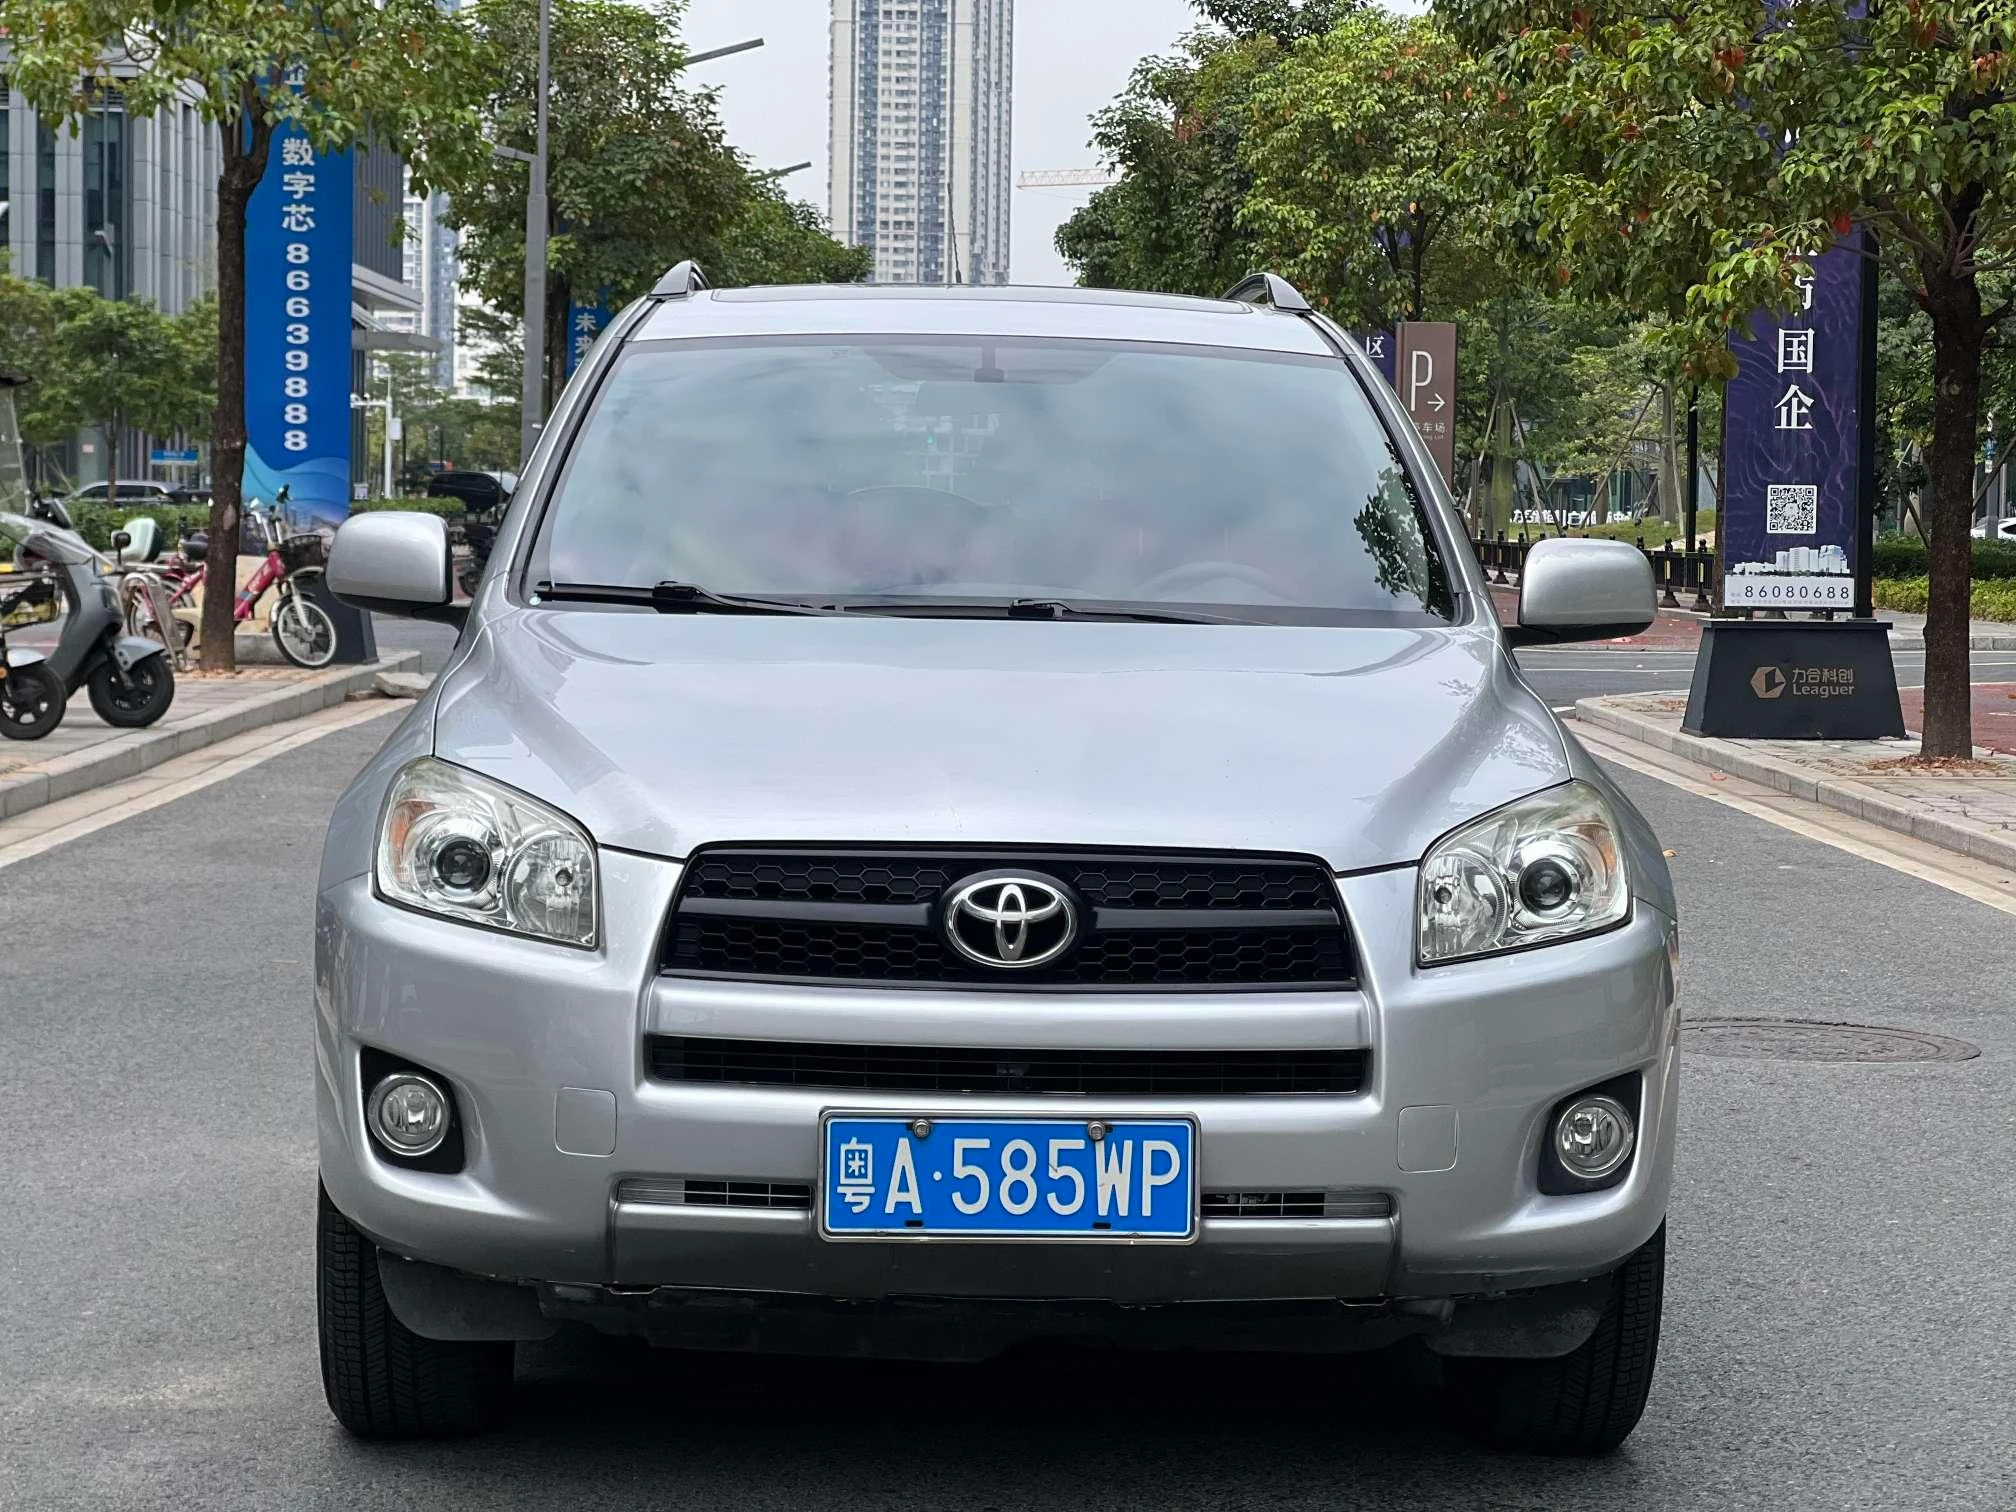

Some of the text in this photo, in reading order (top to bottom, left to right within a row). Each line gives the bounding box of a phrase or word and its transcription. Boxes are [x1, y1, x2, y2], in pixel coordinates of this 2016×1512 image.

[282, 138, 315, 232] 数字芯
[283, 243, 310, 451] 86639888
[1366, 336, 1385, 358] 区
[1410, 350, 1433, 412] P
[1744, 585, 1849, 599] 86080688
[1792, 667, 1853, 683] 力合科创
[1793, 684, 1854, 698] Leaguer
